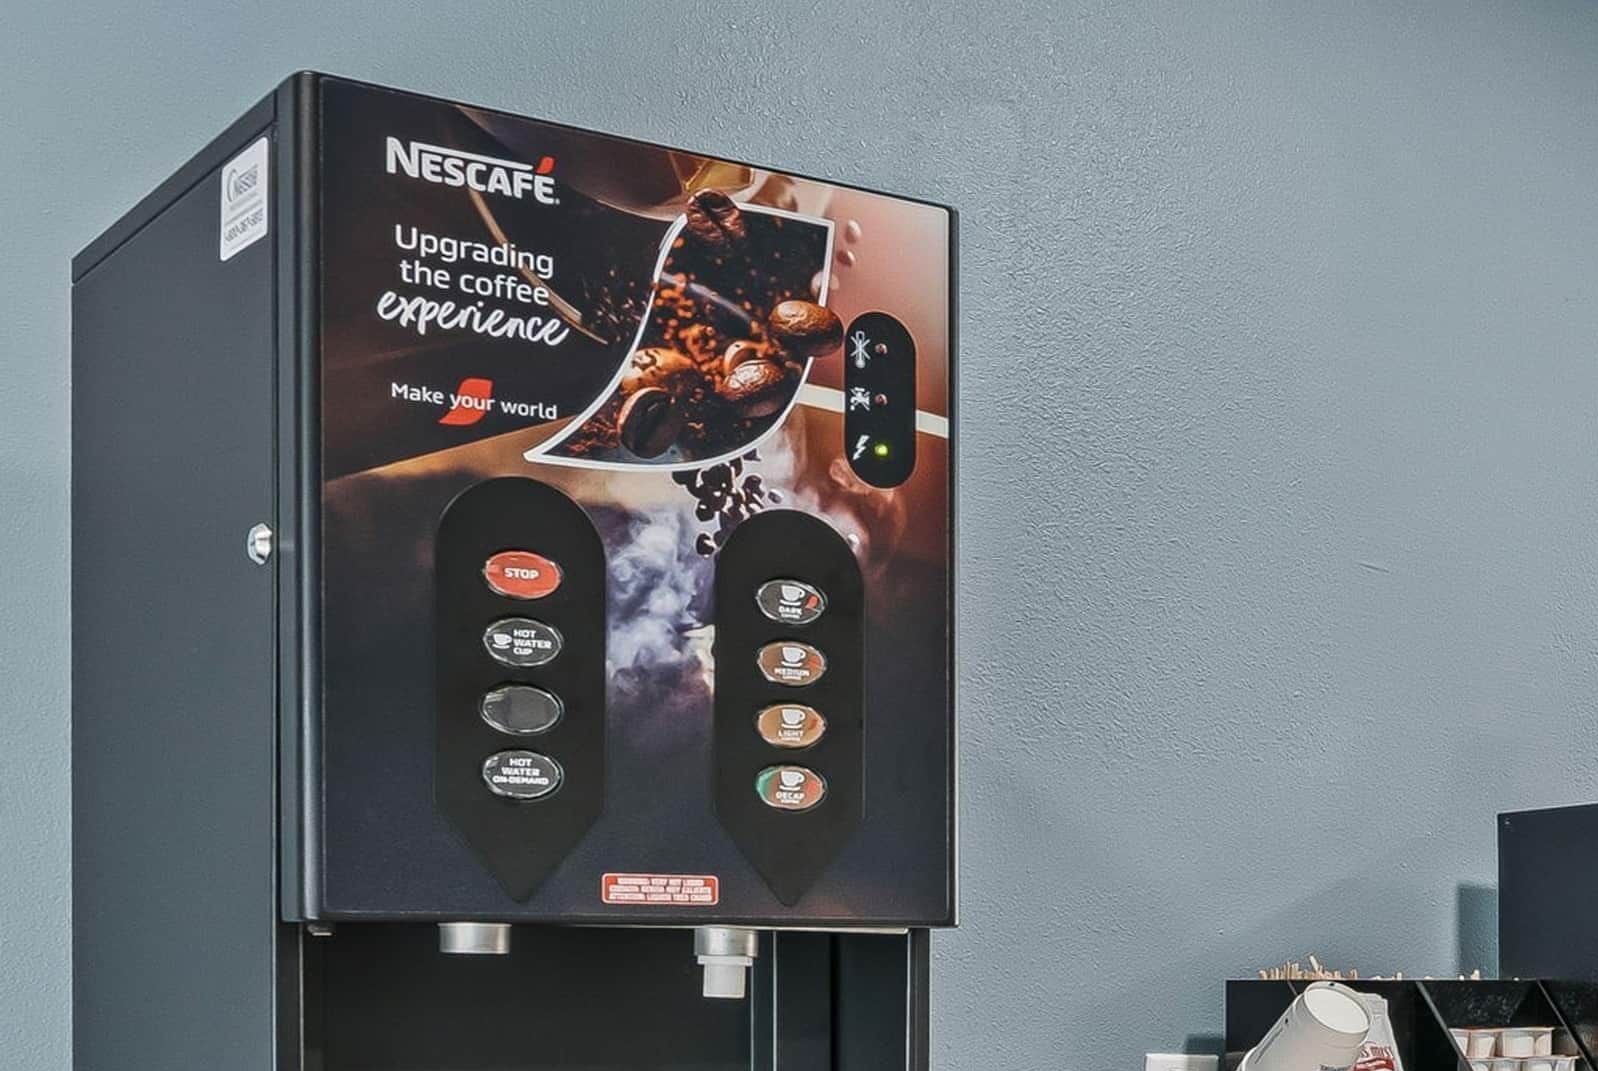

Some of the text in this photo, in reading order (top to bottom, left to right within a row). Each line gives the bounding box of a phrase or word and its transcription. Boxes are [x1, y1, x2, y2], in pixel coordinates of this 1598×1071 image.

[386, 136, 557, 205] NESCAFÉ
[395, 223, 554, 280] Upgrading
[400, 259, 550, 306] the coffee
[376, 290, 570, 346] experience
[391, 382, 558, 420] Make your world
[504, 567, 539, 580] STOP
[513, 628, 536, 639] HOT
[513, 639, 552, 650] WATER
[513, 647, 533, 655] CUP
[509, 758, 532, 767] HOT
[501, 767, 540, 776] WATER
[492, 775, 549, 785] ON-DEMAND
